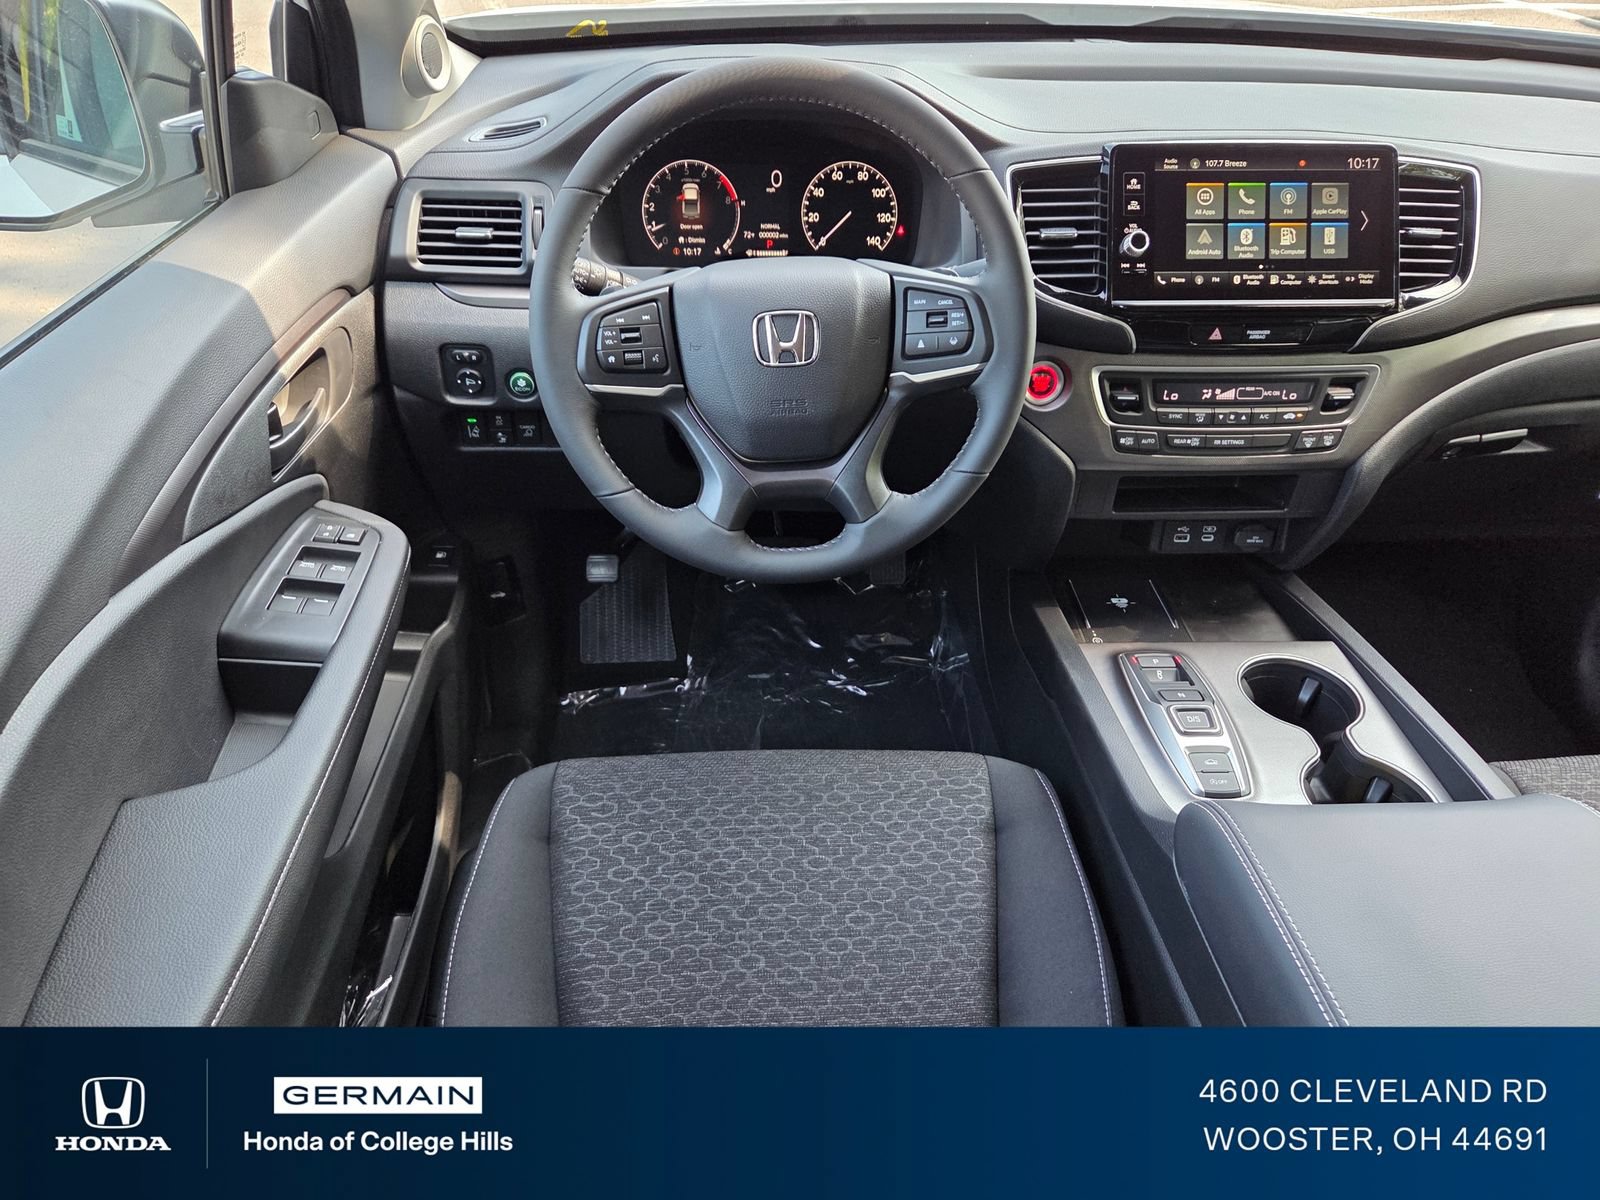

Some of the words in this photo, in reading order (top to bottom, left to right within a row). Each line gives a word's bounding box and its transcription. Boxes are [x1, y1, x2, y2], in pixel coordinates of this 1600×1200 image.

[1205, 160, 1224, 168] 107.7
[1224, 160, 1248, 168] Breeze
[1347, 158, 1380, 169] 10:17
[684, 167, 690, 175] 5
[701, 169, 708, 178] 6
[832, 171, 843, 180] 60
[857, 171, 868, 180] 80
[666, 173, 672, 181] 4
[770, 169, 782, 188] 0
[654, 184, 661, 194] 3
[716, 180, 722, 190] 7
[812, 187, 824, 198] 40
[872, 188, 886, 198] 100
[725, 196, 731, 205] 8
[648, 202, 656, 212] 2
[808, 212, 820, 222] 20
[876, 212, 892, 223] 120
[662, 236, 668, 245] 0
[766, 240, 774, 248] P
[866, 236, 882, 246] 140
[683, 248, 702, 256] 10:17
[1163, 390, 1179, 400] Lo
[1282, 390, 1298, 400] Lo
